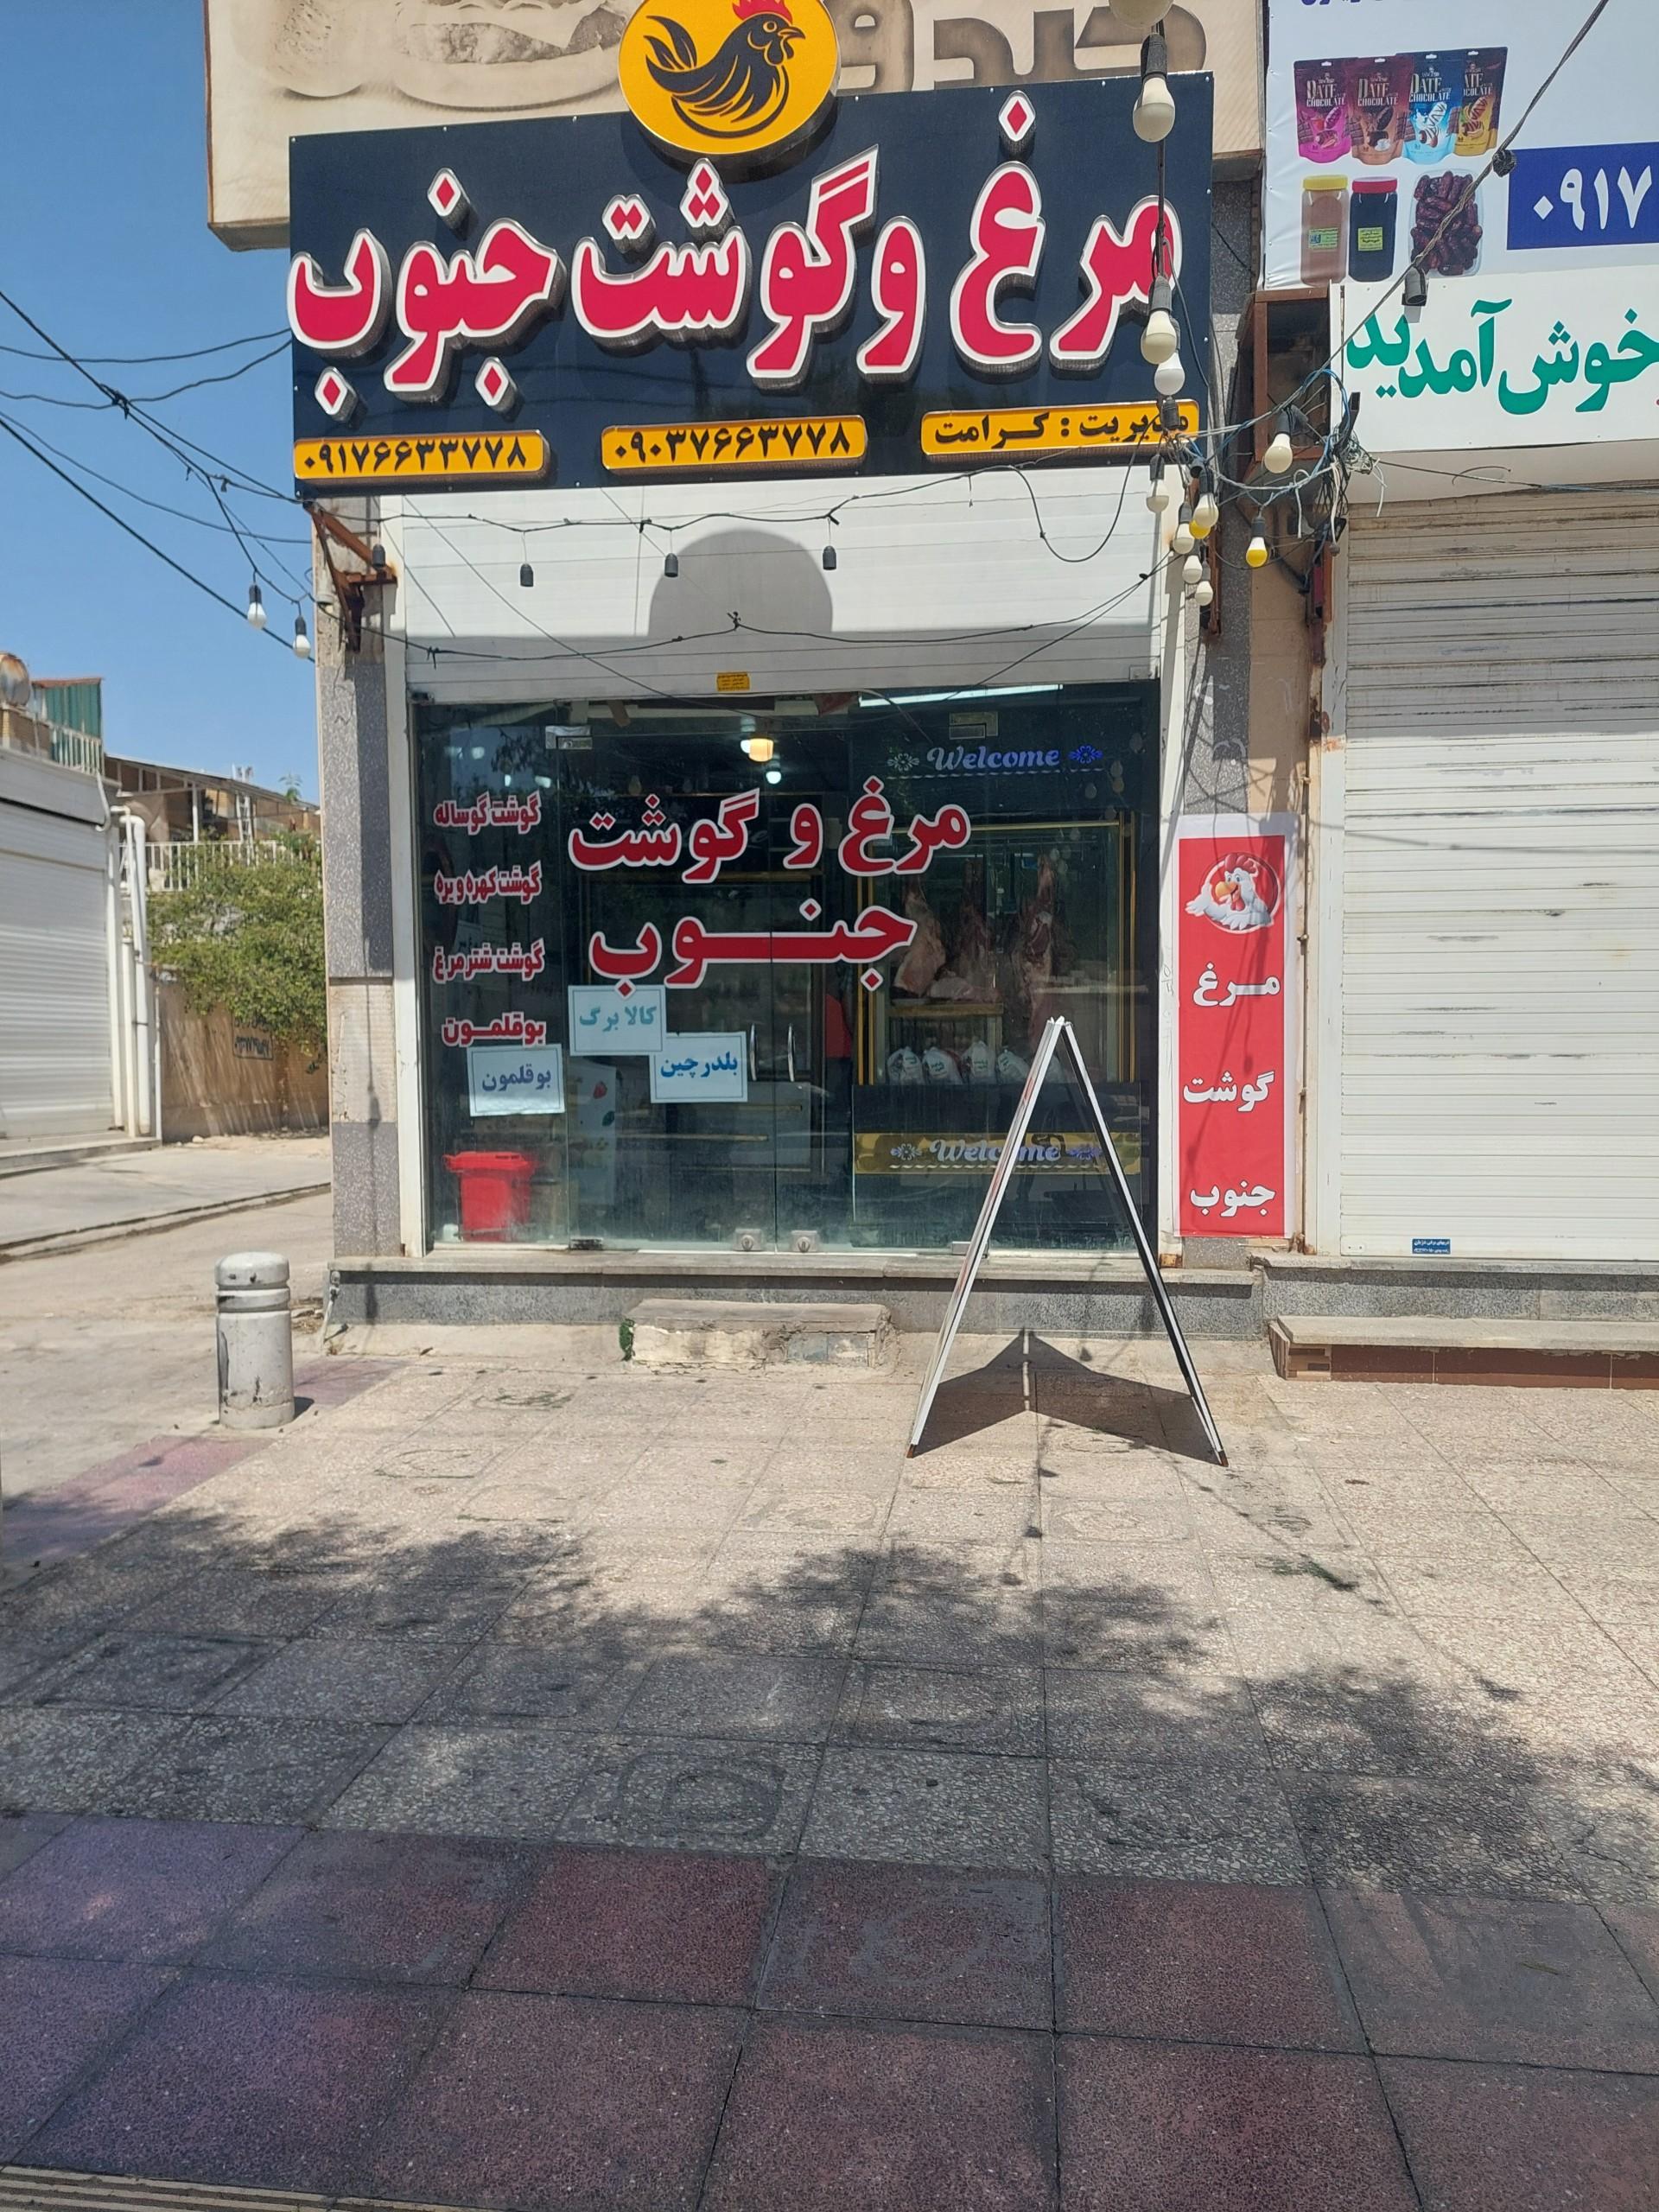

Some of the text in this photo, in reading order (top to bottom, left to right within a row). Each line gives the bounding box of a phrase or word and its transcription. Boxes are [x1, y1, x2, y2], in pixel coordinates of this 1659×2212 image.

[1306, 79, 1338, 99] DATE
[1358, 78, 1389, 98] DATE
[1408, 92, 1451, 103] CHOCOLATE
[1410, 73, 1442, 94] DATE
[1465, 73, 1484, 88] ATE
[1306, 95, 1345, 107] CHOCOLATE
[1357, 96, 1398, 106] CHOCOLATE
[287, 90, 1182, 416] مرغ و گوشت جنوب
[1346, 298, 1659, 416] خوش آمدید
[615, 422, 851, 463] ۰۹۰۳۷۶۶۳۷۷۸
[935, 411, 1050, 448] کرامت
[303, 435, 527, 474] ۰۹۱۷۶۶۳۳۷۷۸
[926, 745, 1061, 771] Welcome
[433, 790, 542, 836] گوشت گوساله
[569, 776, 971, 884] مرغ و گوشت
[498, 860, 543, 905] گوشت
[495, 938, 545, 982] گوشت
[589, 898, 918, 1000] جنوب
[1192, 962, 1281, 1007] مرغ
[442, 1012, 546, 1048] بوقلمون
[482, 1063, 552, 1092] بوقلمون
[661, 1051, 739, 1078] بلدرچین
[1183, 1071, 1275, 1112] گوشت
[930, 1139, 1061, 1162] Welcme
[1190, 1179, 1276, 1217] جنوب
